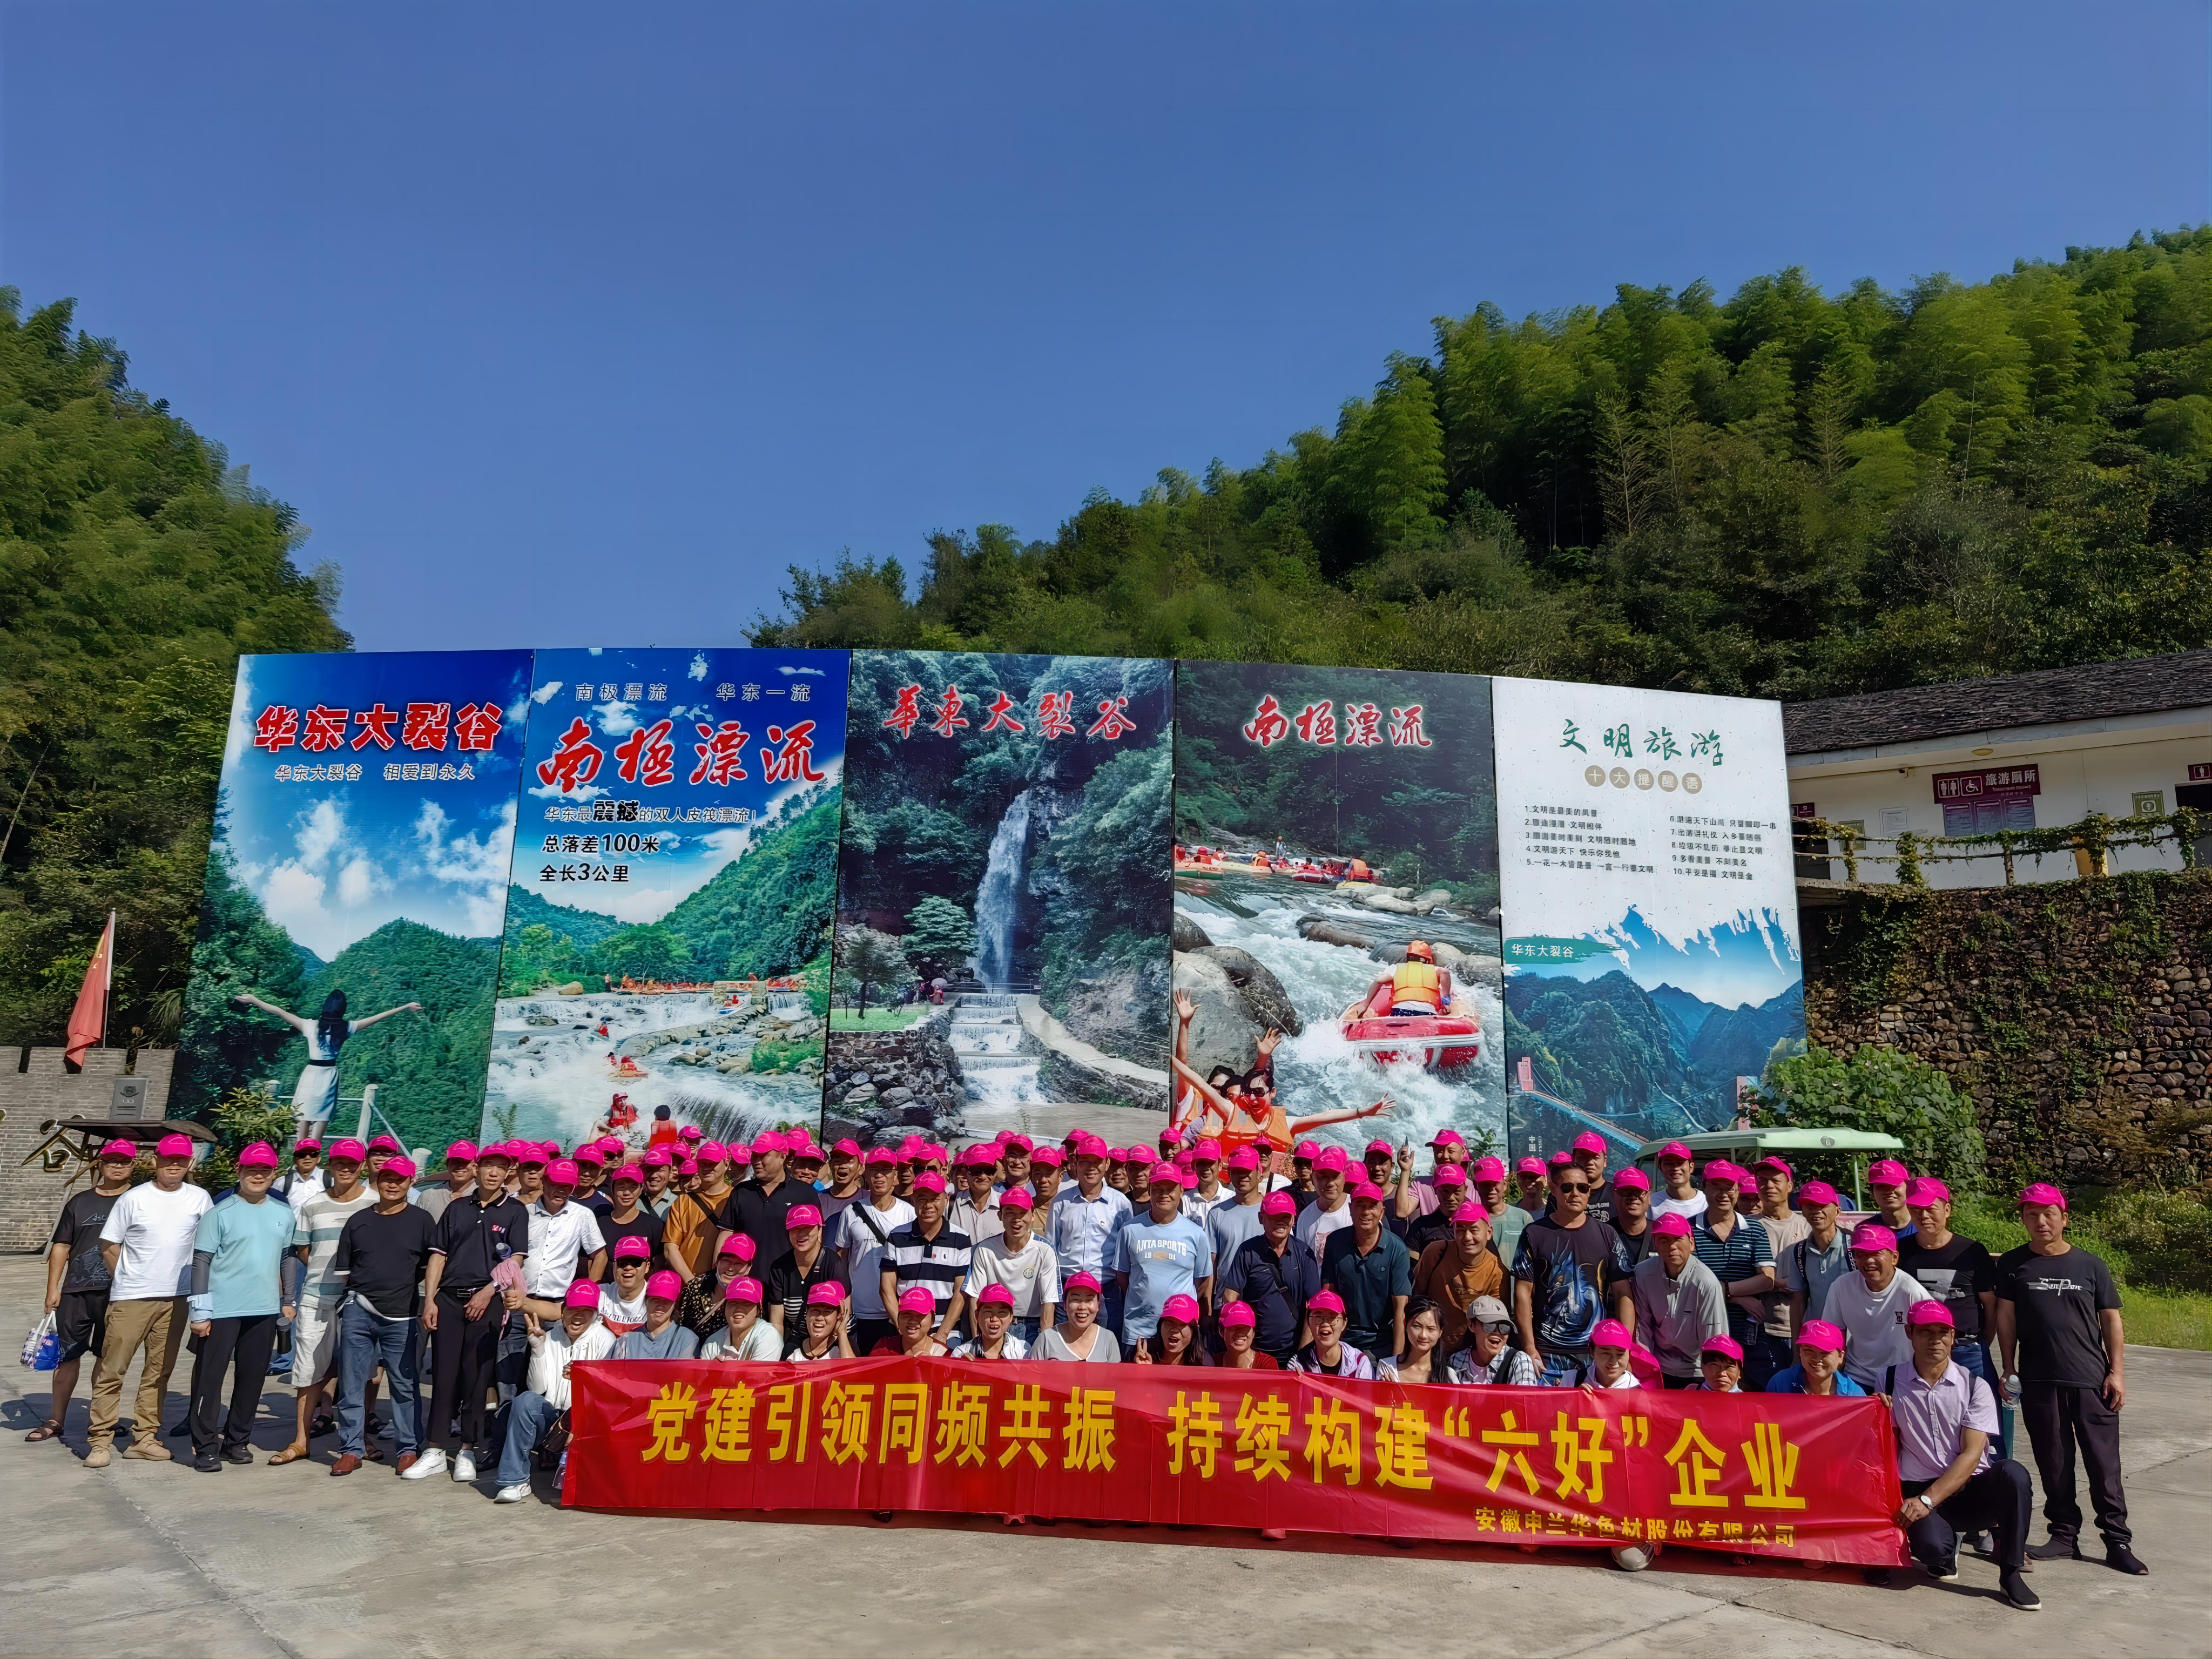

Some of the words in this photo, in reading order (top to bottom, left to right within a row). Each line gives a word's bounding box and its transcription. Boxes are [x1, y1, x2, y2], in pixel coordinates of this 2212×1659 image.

[576, 683, 667, 702] 南极漂流
[716, 683, 811, 702] 华东一流
[253, 702, 503, 752] 华东大裂谷
[1560, 719, 1723, 766] 文明旅游
[275, 764, 363, 781] 华东大裂谷
[384, 763, 475, 781] 相爱到永久
[1588, 768, 1699, 790] 十大提醒语
[1525, 805, 1597, 817] 1.文明是美的风
[1670, 816, 1724, 826] 6.天下山川
[542, 833, 659, 853] 总落差100米
[1723, 845, 1762, 855] 止文明
[540, 863, 629, 882] 全长3公里
[1597, 863, 1654, 874] 一一行文明
[1674, 868, 1716, 878] 10.平安是
[1512, 943, 1574, 957] 华东大裂谷
[641, 1379, 1117, 1473] 党建引领同频共振
[1166, 1390, 1806, 1509] 持续构建“六好”企业
[1475, 1507, 1795, 1548] 安徽申兰华色材股份有限公司
